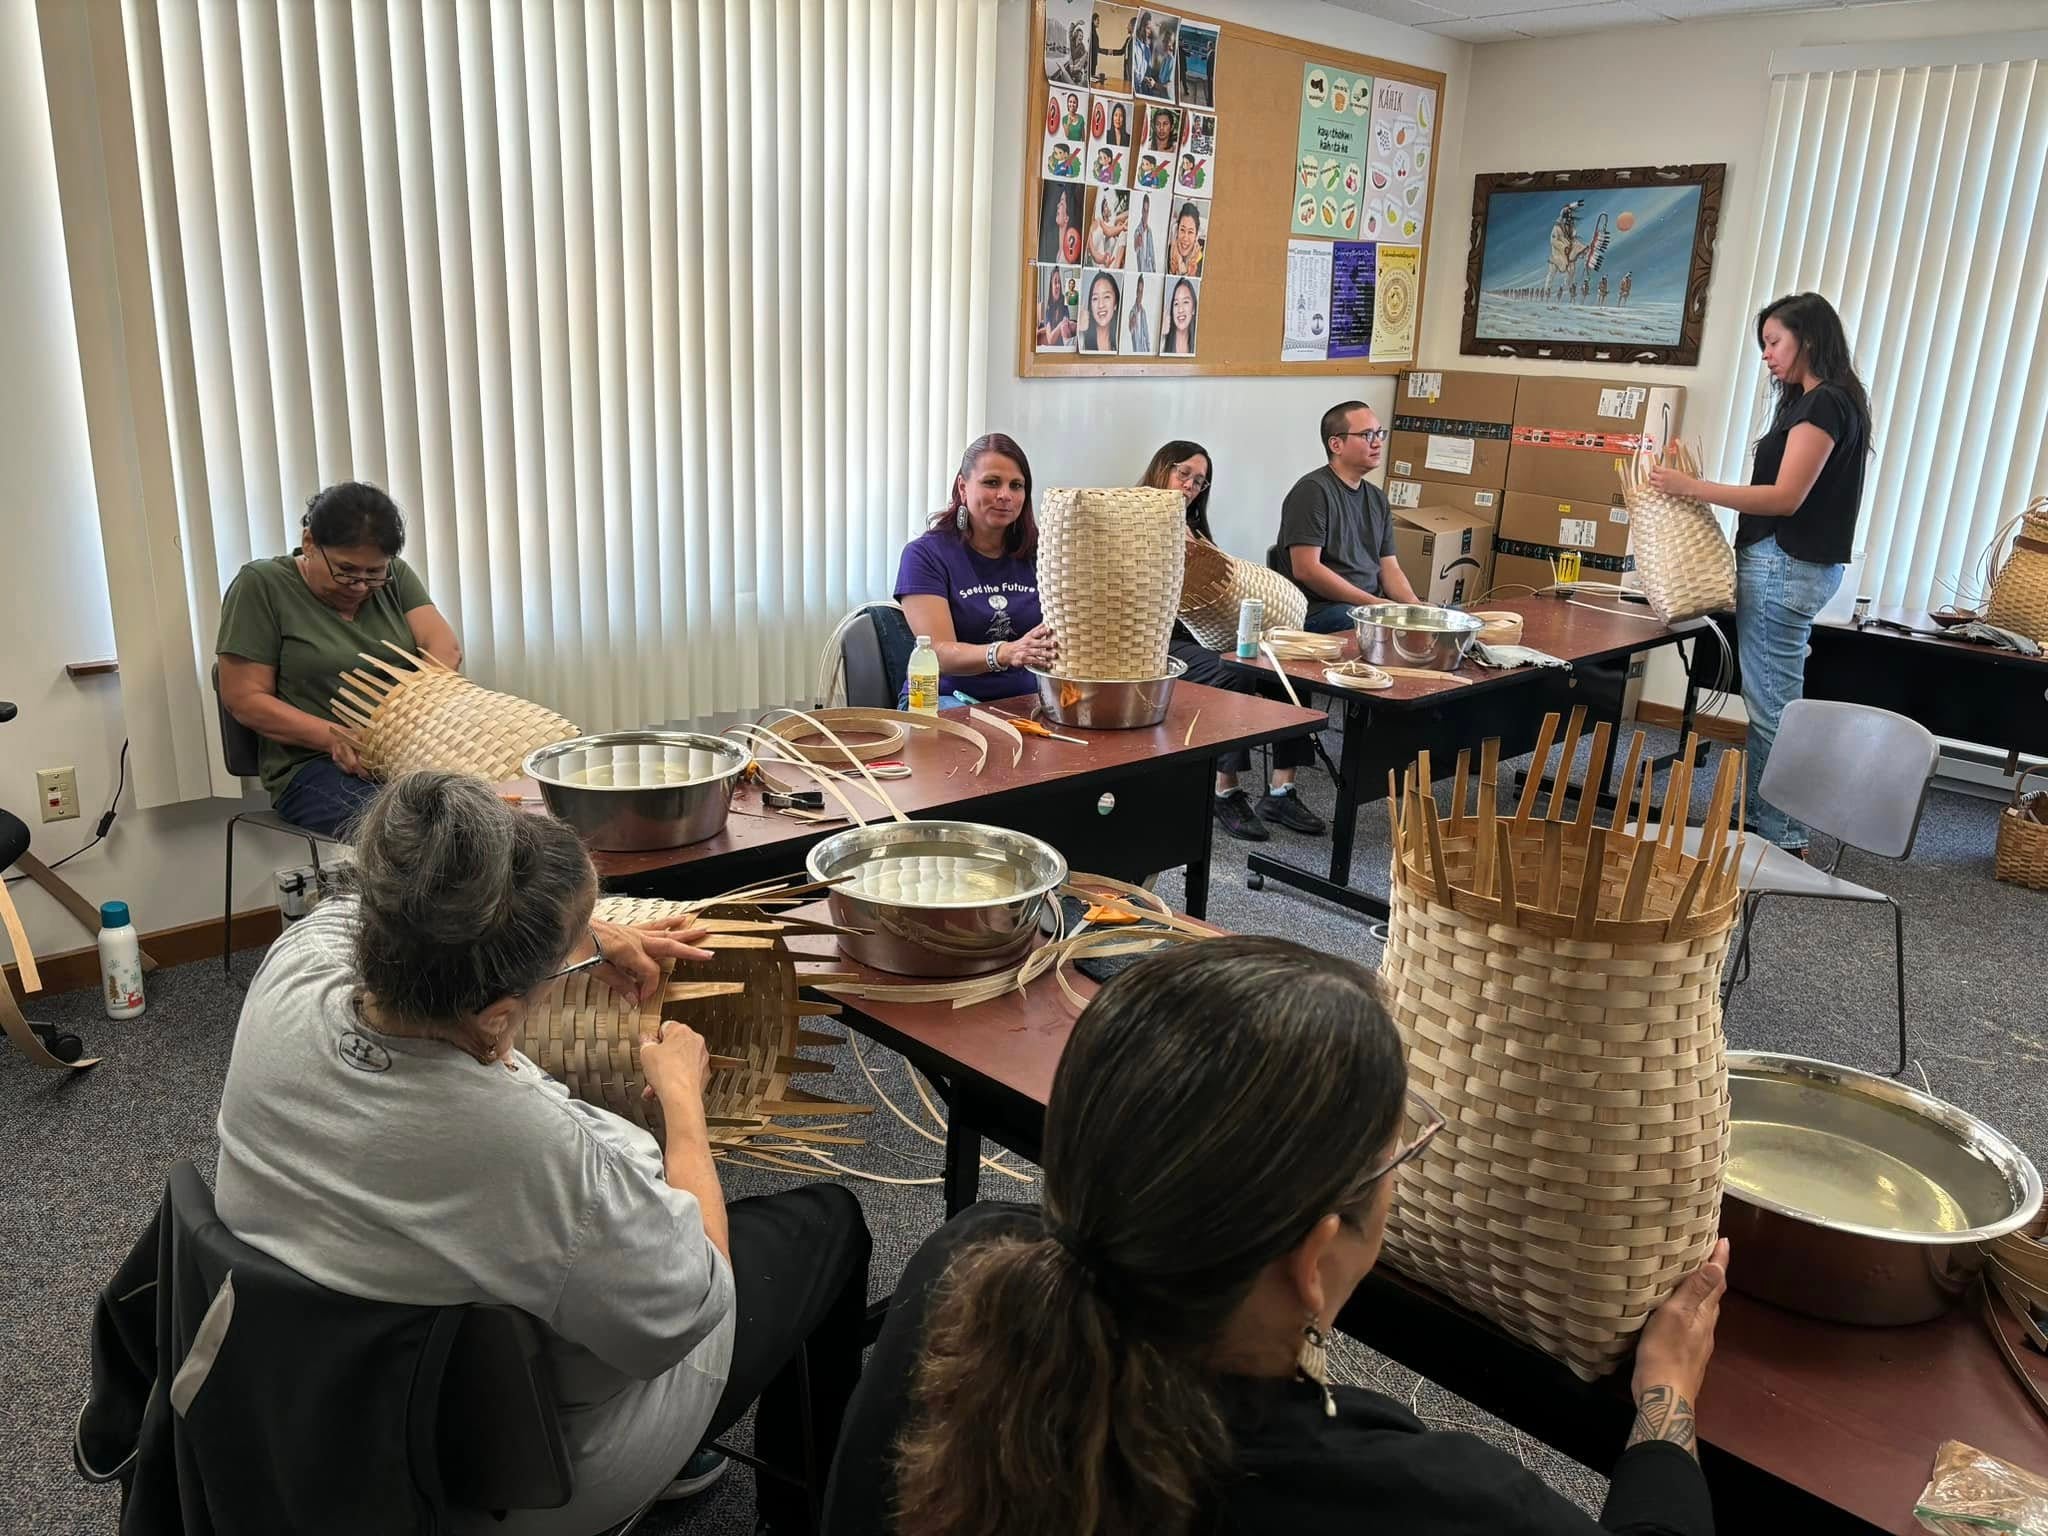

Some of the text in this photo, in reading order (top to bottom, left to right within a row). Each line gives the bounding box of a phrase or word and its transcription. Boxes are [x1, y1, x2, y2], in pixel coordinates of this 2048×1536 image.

[959, 582, 1036, 599] Seed the Future
